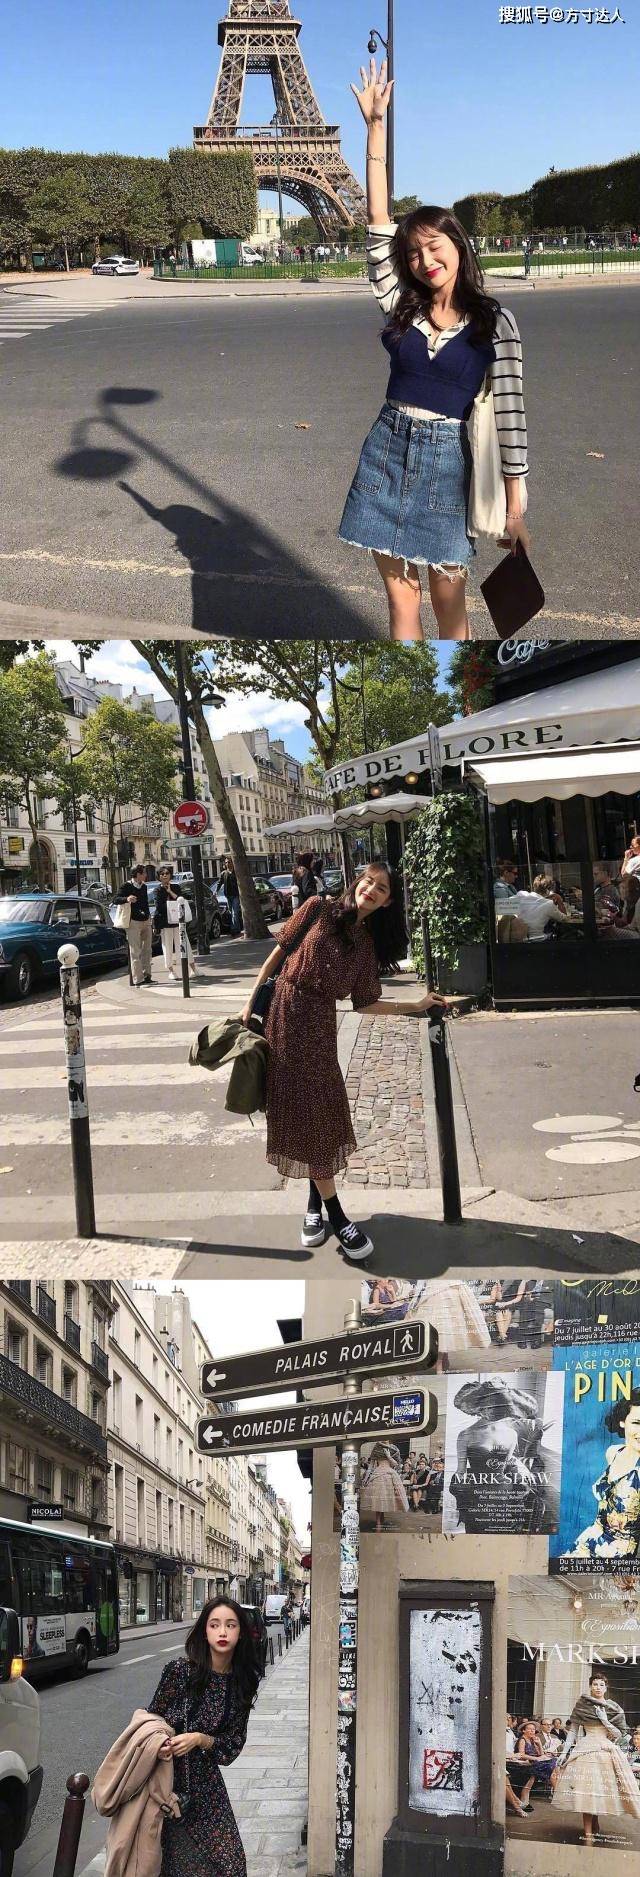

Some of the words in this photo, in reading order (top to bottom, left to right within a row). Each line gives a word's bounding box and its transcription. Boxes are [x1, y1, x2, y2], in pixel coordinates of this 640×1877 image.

[365, 754, 402, 778] DE
[572, 1326, 592, 1334] juillet
[575, 1332, 598, 1342] jusqu'à
[275, 1350, 328, 1374] PALAIS
[339, 1339, 392, 1362] ROYAL
[583, 1348, 628, 1359] galerie
[566, 1360, 597, 1370] L'AGE
[602, 1358, 631, 1368] D'OR
[575, 1370, 633, 1403] PIN
[233, 1417, 297, 1439] COMEDIE
[302, 1405, 391, 1431] FRANÇAISE
[453, 1472, 502, 1484] MARK
[576, 1558, 594, 1566] juillet
[40, 1629, 64, 1640] SLEEPLESS
[520, 1642, 608, 1664] MARK
